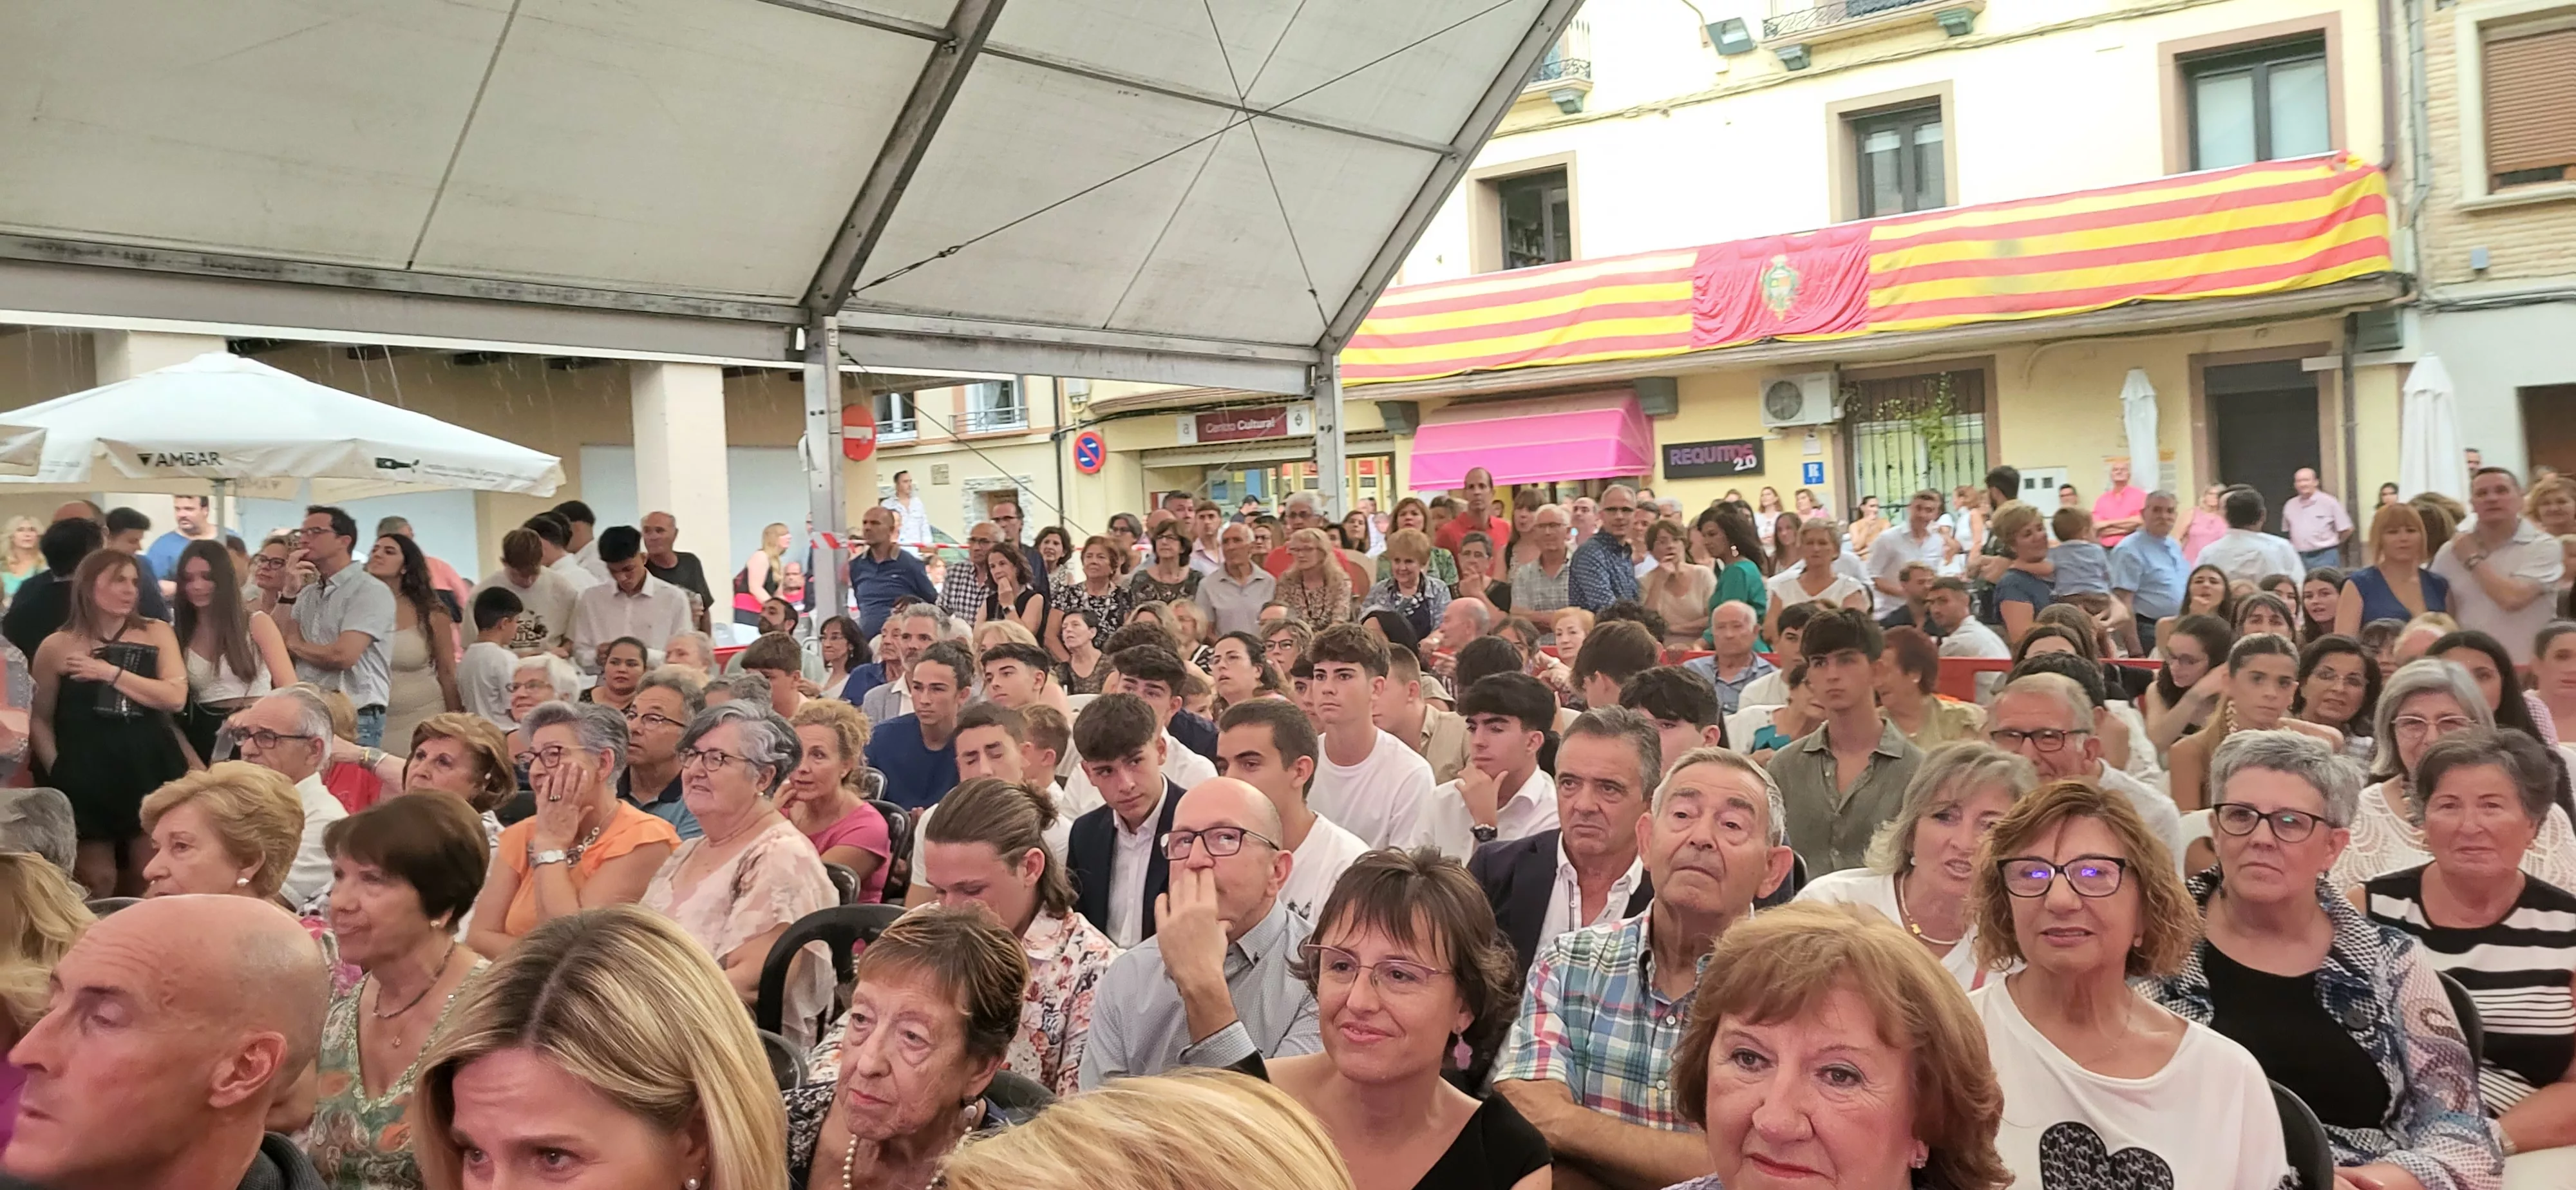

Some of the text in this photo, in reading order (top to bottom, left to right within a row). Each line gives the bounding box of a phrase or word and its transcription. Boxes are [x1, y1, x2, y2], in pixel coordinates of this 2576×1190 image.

[1206, 418, 1275, 433] Centro Cultural
[155, 451, 223, 467] AMBAR
[1671, 444, 1753, 465] REQUITOS
[1733, 454, 1757, 471] 2.0
